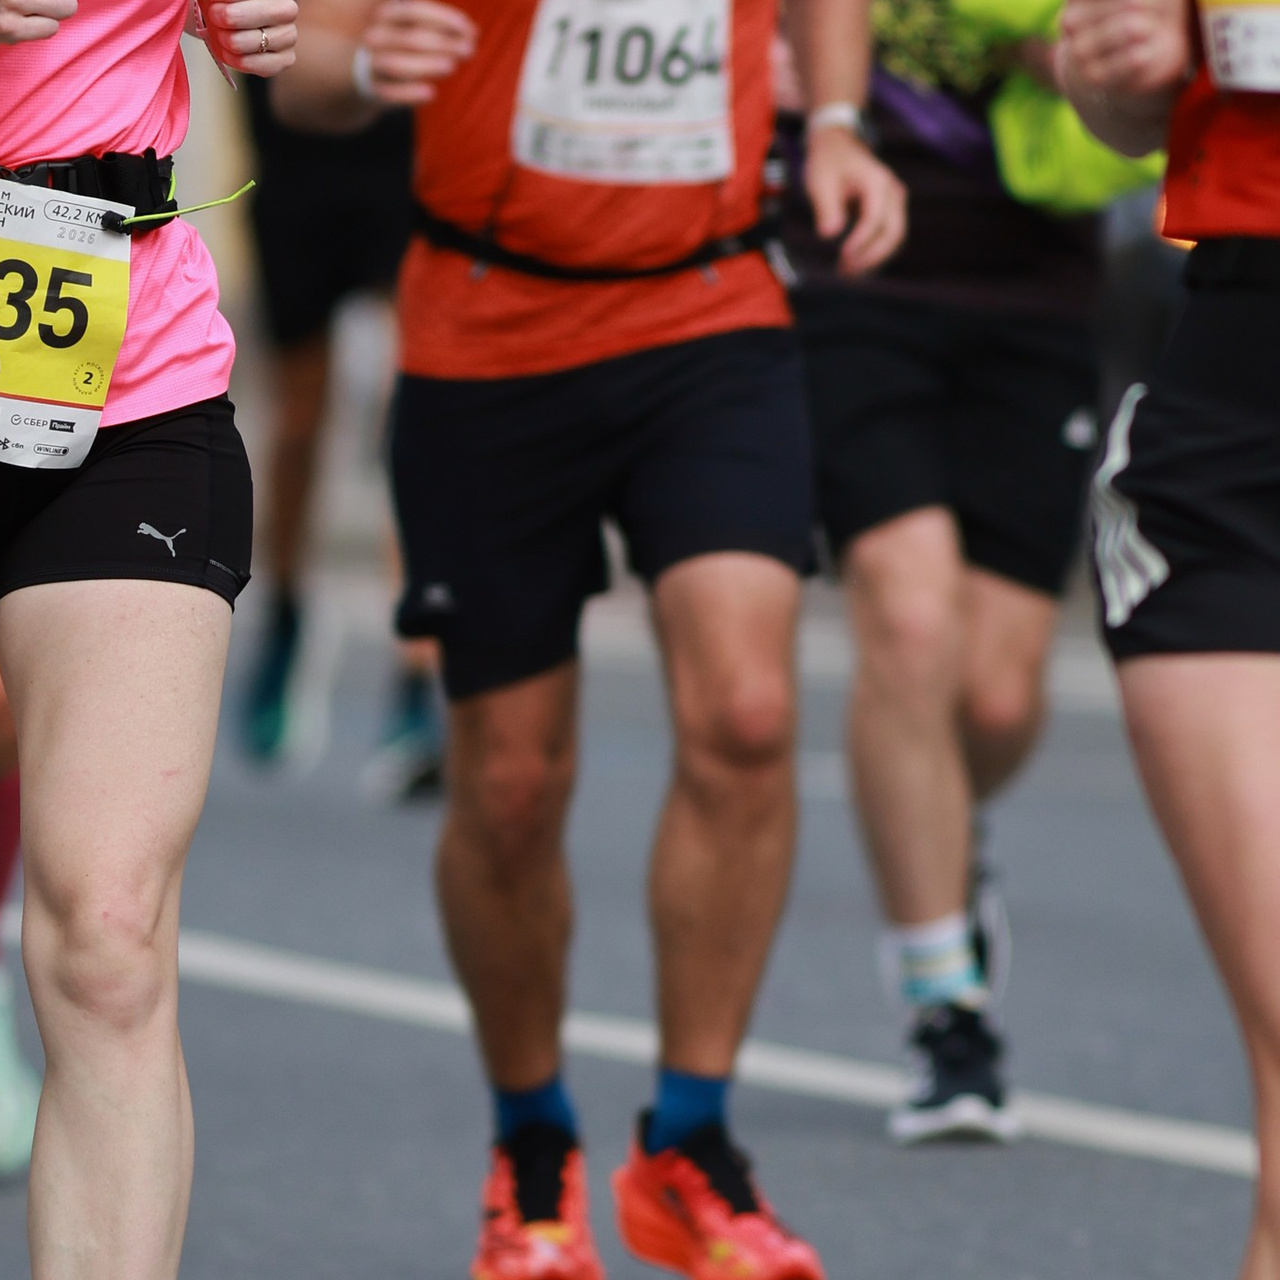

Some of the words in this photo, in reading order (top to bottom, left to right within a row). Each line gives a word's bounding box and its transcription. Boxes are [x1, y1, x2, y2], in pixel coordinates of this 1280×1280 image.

[52, 205, 82, 220] 42,2
[57, 226, 96, 244] 2026
[83, 371, 93, 385] 2
[23, 417, 48, 428] СБЕР
[36, 446, 62, 455] WINLINE
